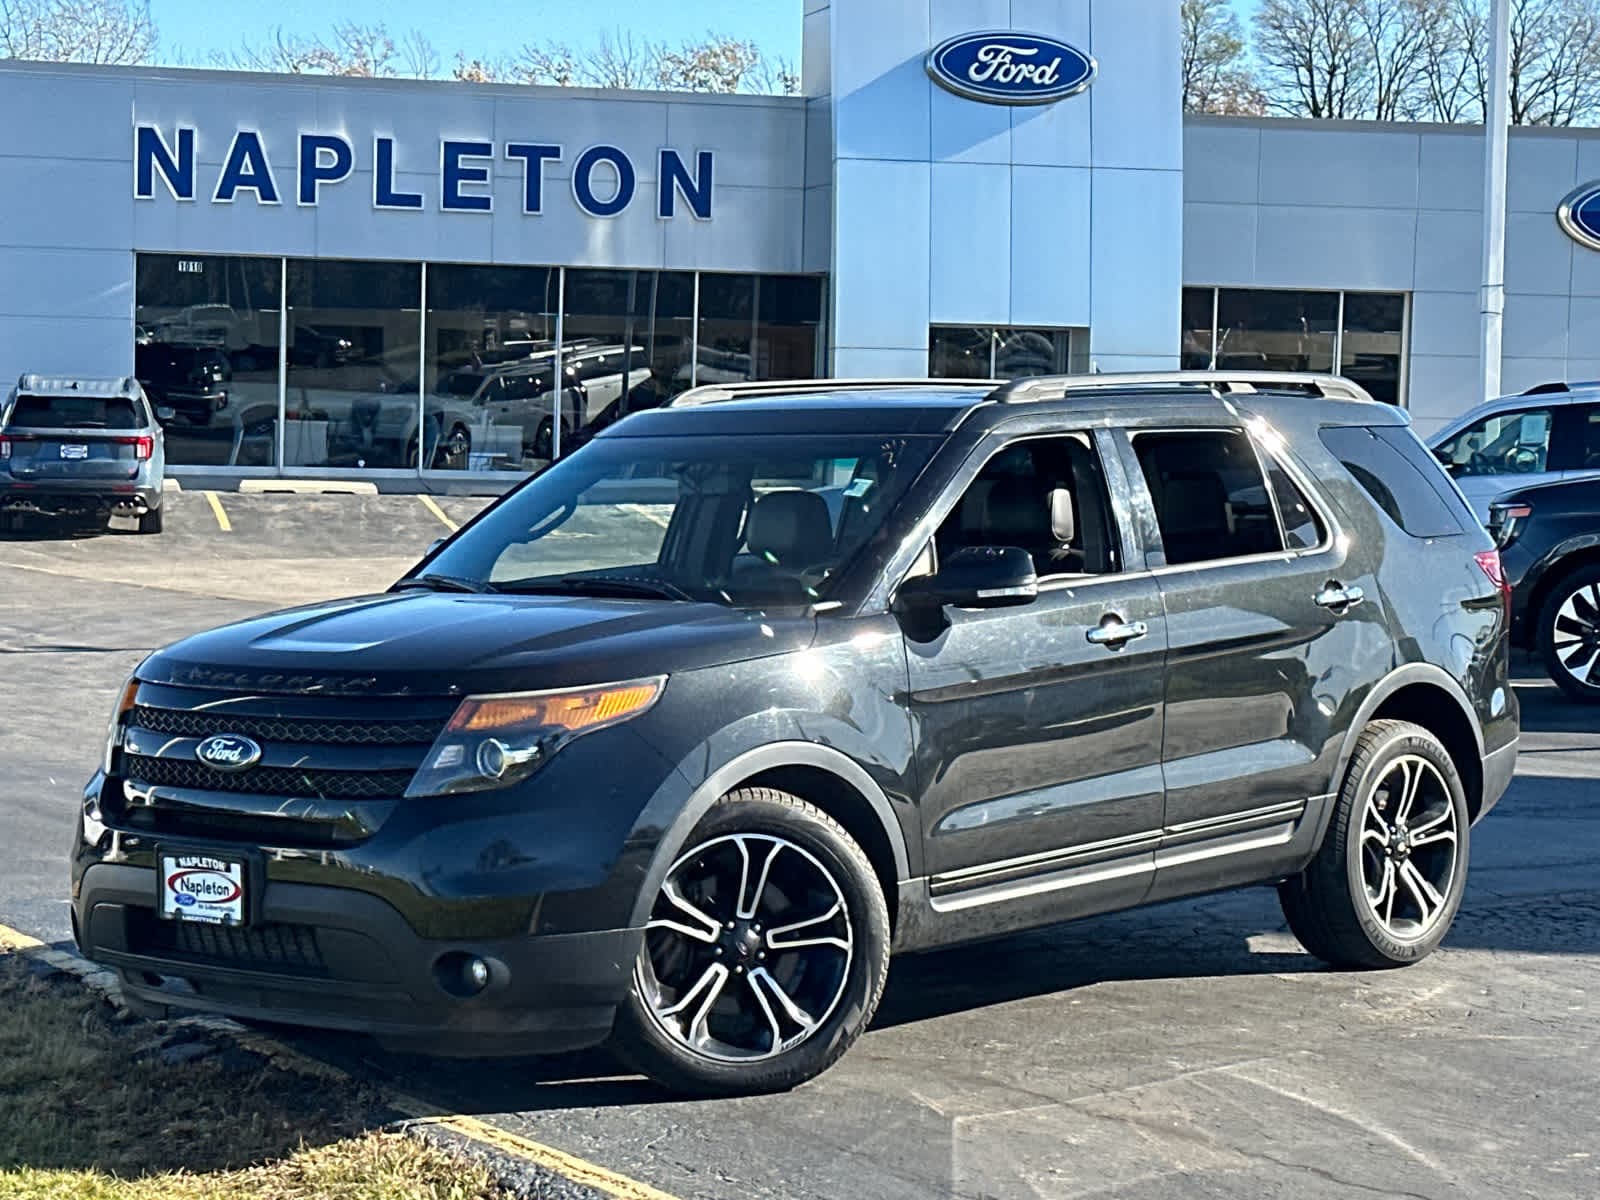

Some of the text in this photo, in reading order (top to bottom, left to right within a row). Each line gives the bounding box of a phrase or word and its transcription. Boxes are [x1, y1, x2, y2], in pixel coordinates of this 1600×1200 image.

[968, 44, 1062, 85] Ford
[134, 124, 715, 221] NAPLETON
[178, 260, 203, 273] 1010
[206, 739, 243, 761] Ford
[179, 857, 225, 871] NAPLETON
[180, 877, 230, 896] Napleton
